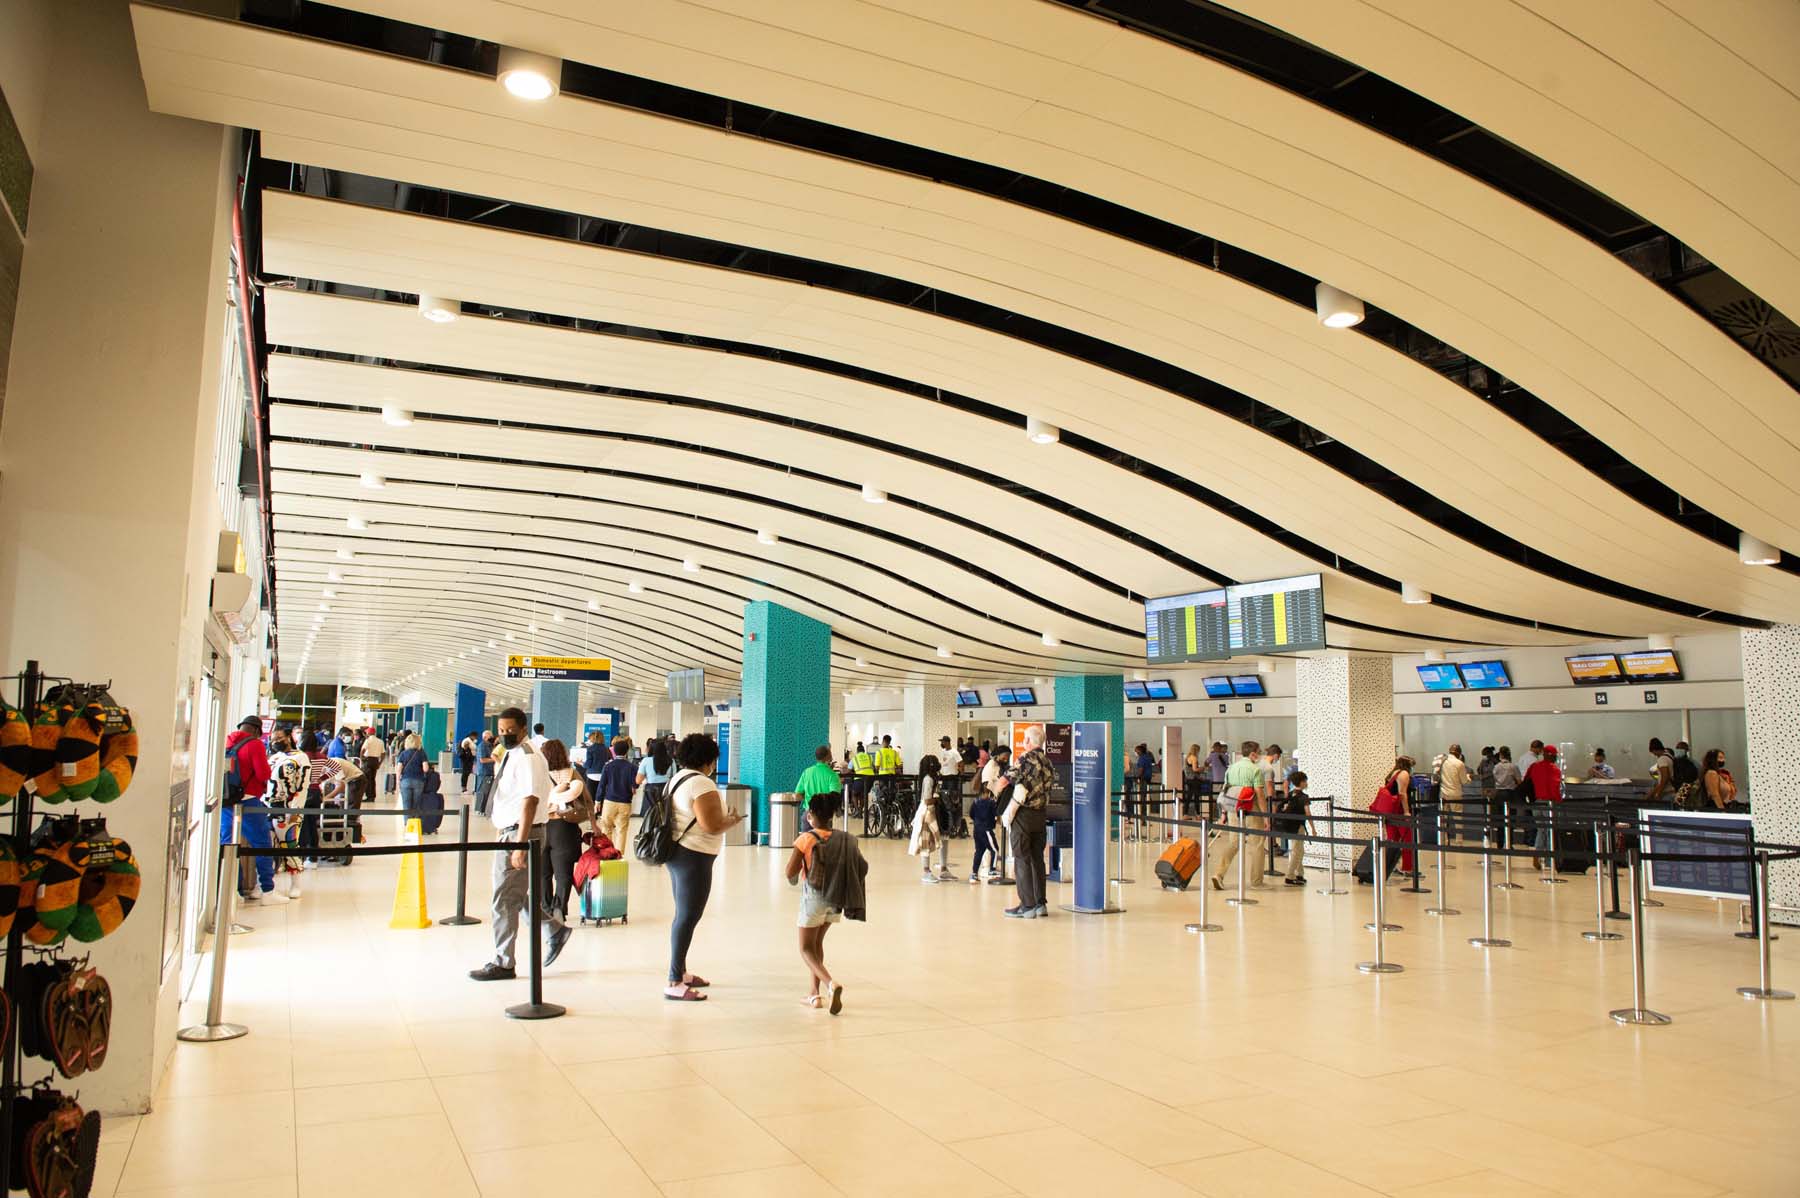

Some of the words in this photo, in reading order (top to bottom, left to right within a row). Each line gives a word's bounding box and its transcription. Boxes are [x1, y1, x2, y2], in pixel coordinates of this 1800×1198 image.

[560, 658, 592, 666] departures
[1646, 693, 1655, 701] 53
[1046, 740, 1064, 748] Upper
[1083, 749, 1099, 758] DESK
